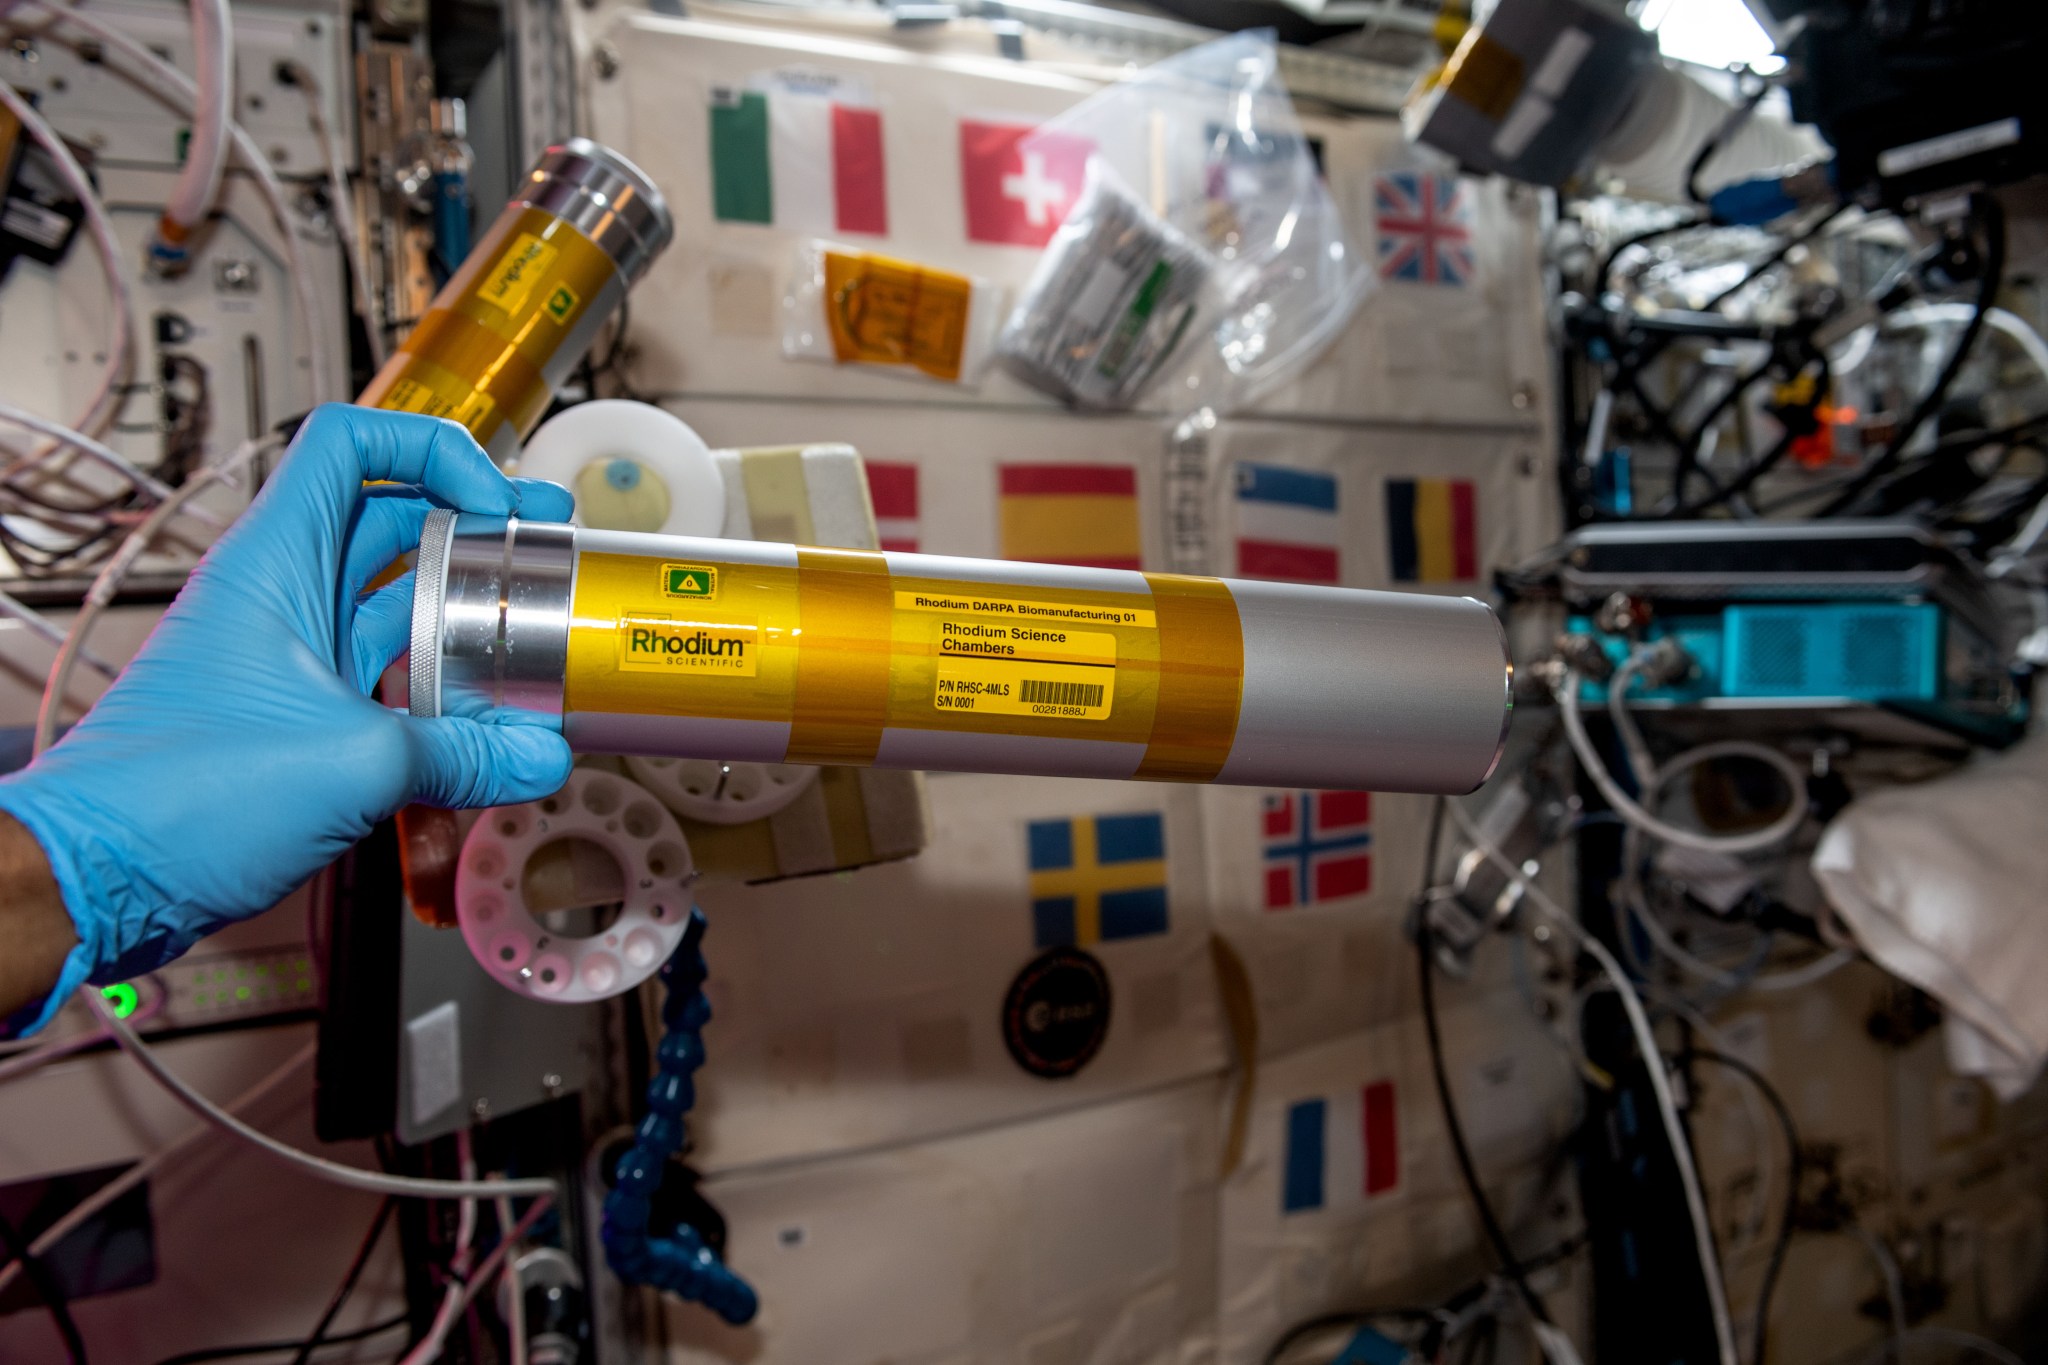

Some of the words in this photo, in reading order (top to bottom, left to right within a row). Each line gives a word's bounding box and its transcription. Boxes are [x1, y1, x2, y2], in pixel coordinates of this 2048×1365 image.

[915, 597, 970, 610] Rhodium
[973, 601, 1015, 614] DARPA
[1018, 604, 1121, 623] Biomanufacturing
[1123, 612, 1136, 623] 01
[942, 622, 1007, 639] Rhodium
[1010, 627, 1067, 643] Science
[942, 638, 1015, 655] Chambers
[666, 657, 743, 668] SCIENTIFIC
[938, 680, 955, 692] P/N
[956, 681, 1010, 696] RHSC-4MLS
[937, 695, 954, 708] S/N
[954, 696, 975, 709] 0001
